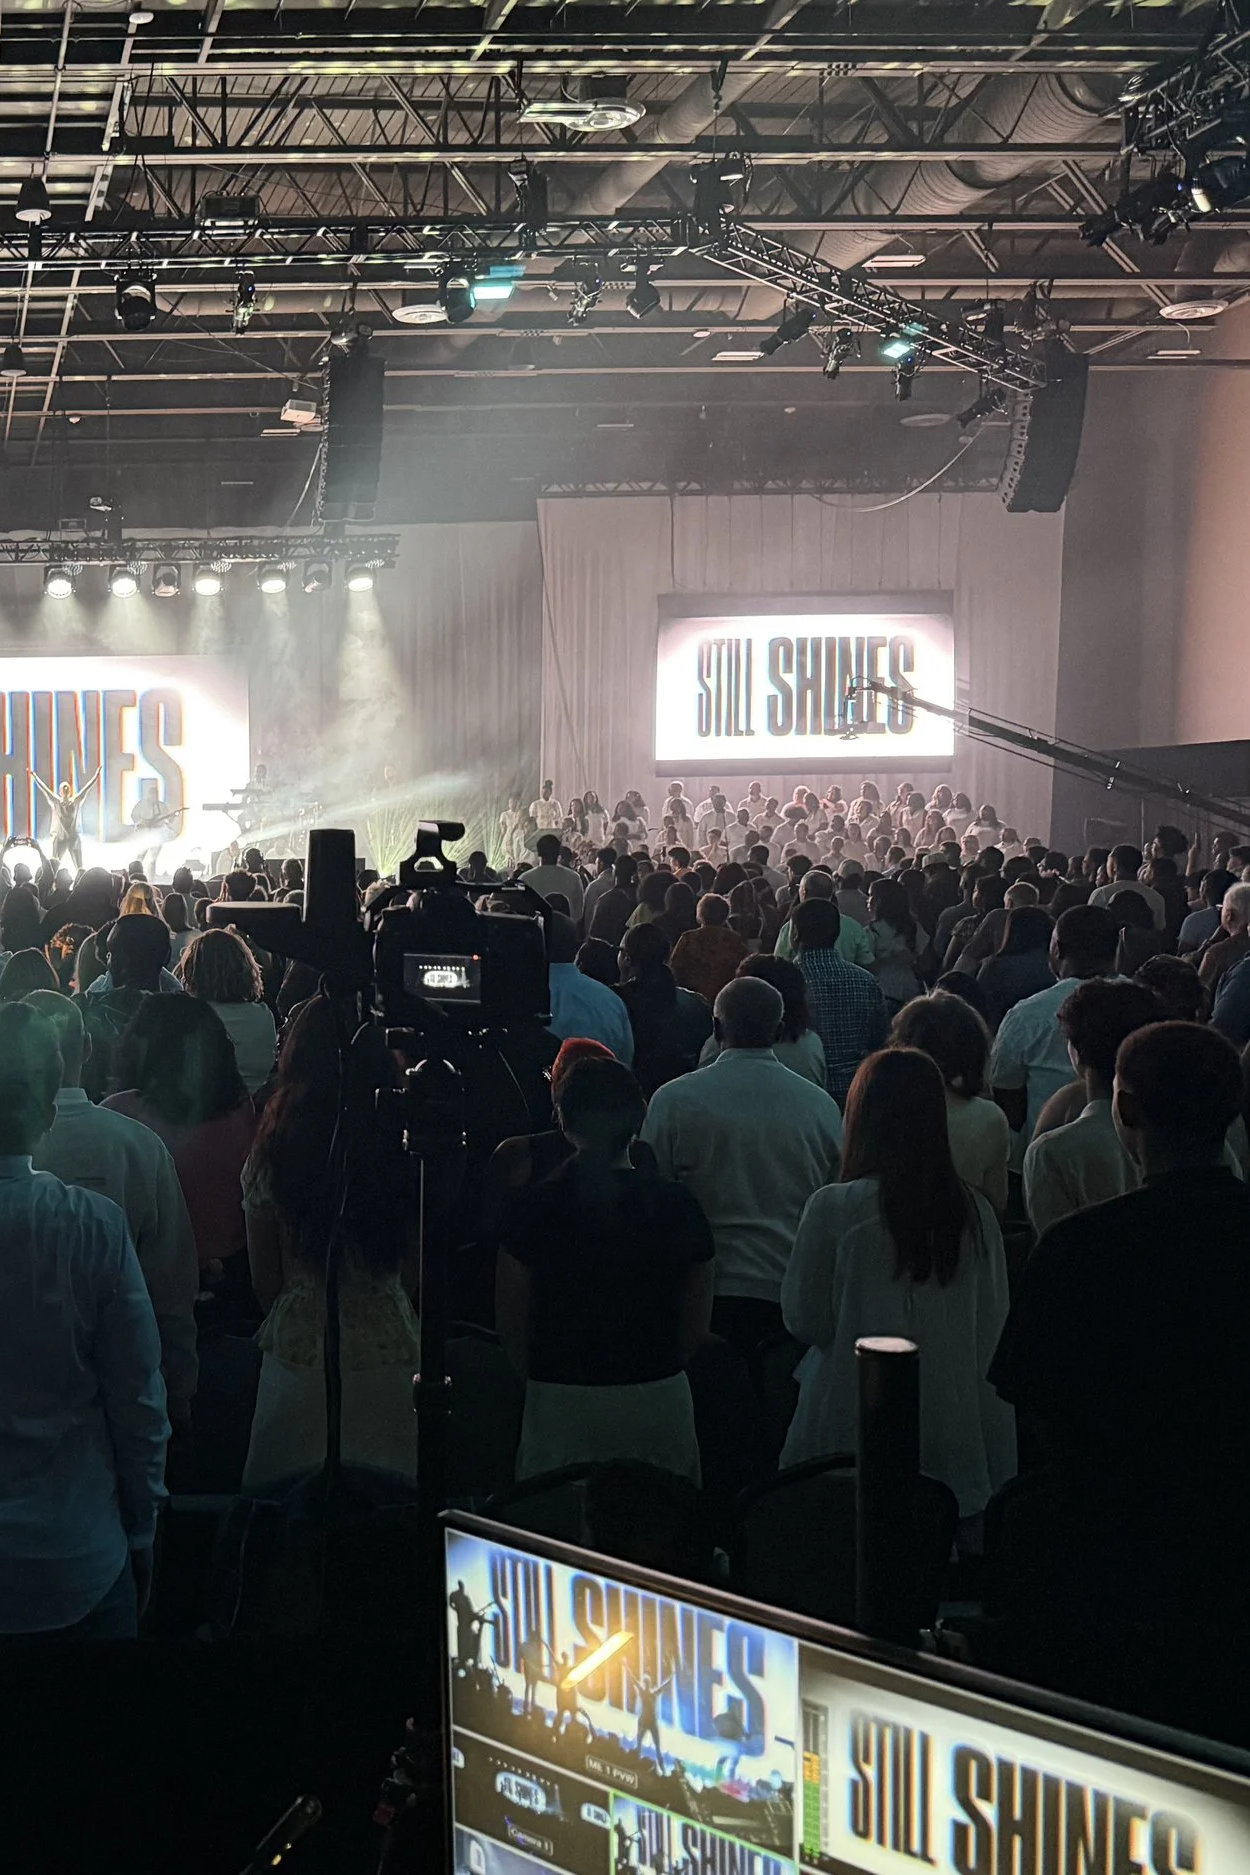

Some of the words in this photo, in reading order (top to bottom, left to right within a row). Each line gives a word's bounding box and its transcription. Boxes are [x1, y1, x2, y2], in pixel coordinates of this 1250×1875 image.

[697, 638, 755, 737] STILL
[766, 635, 916, 737] SHINES
[488, 1549, 556, 1684] STILL
[570, 1572, 766, 1757] SHINES
[851, 1706, 938, 1867] STILL
